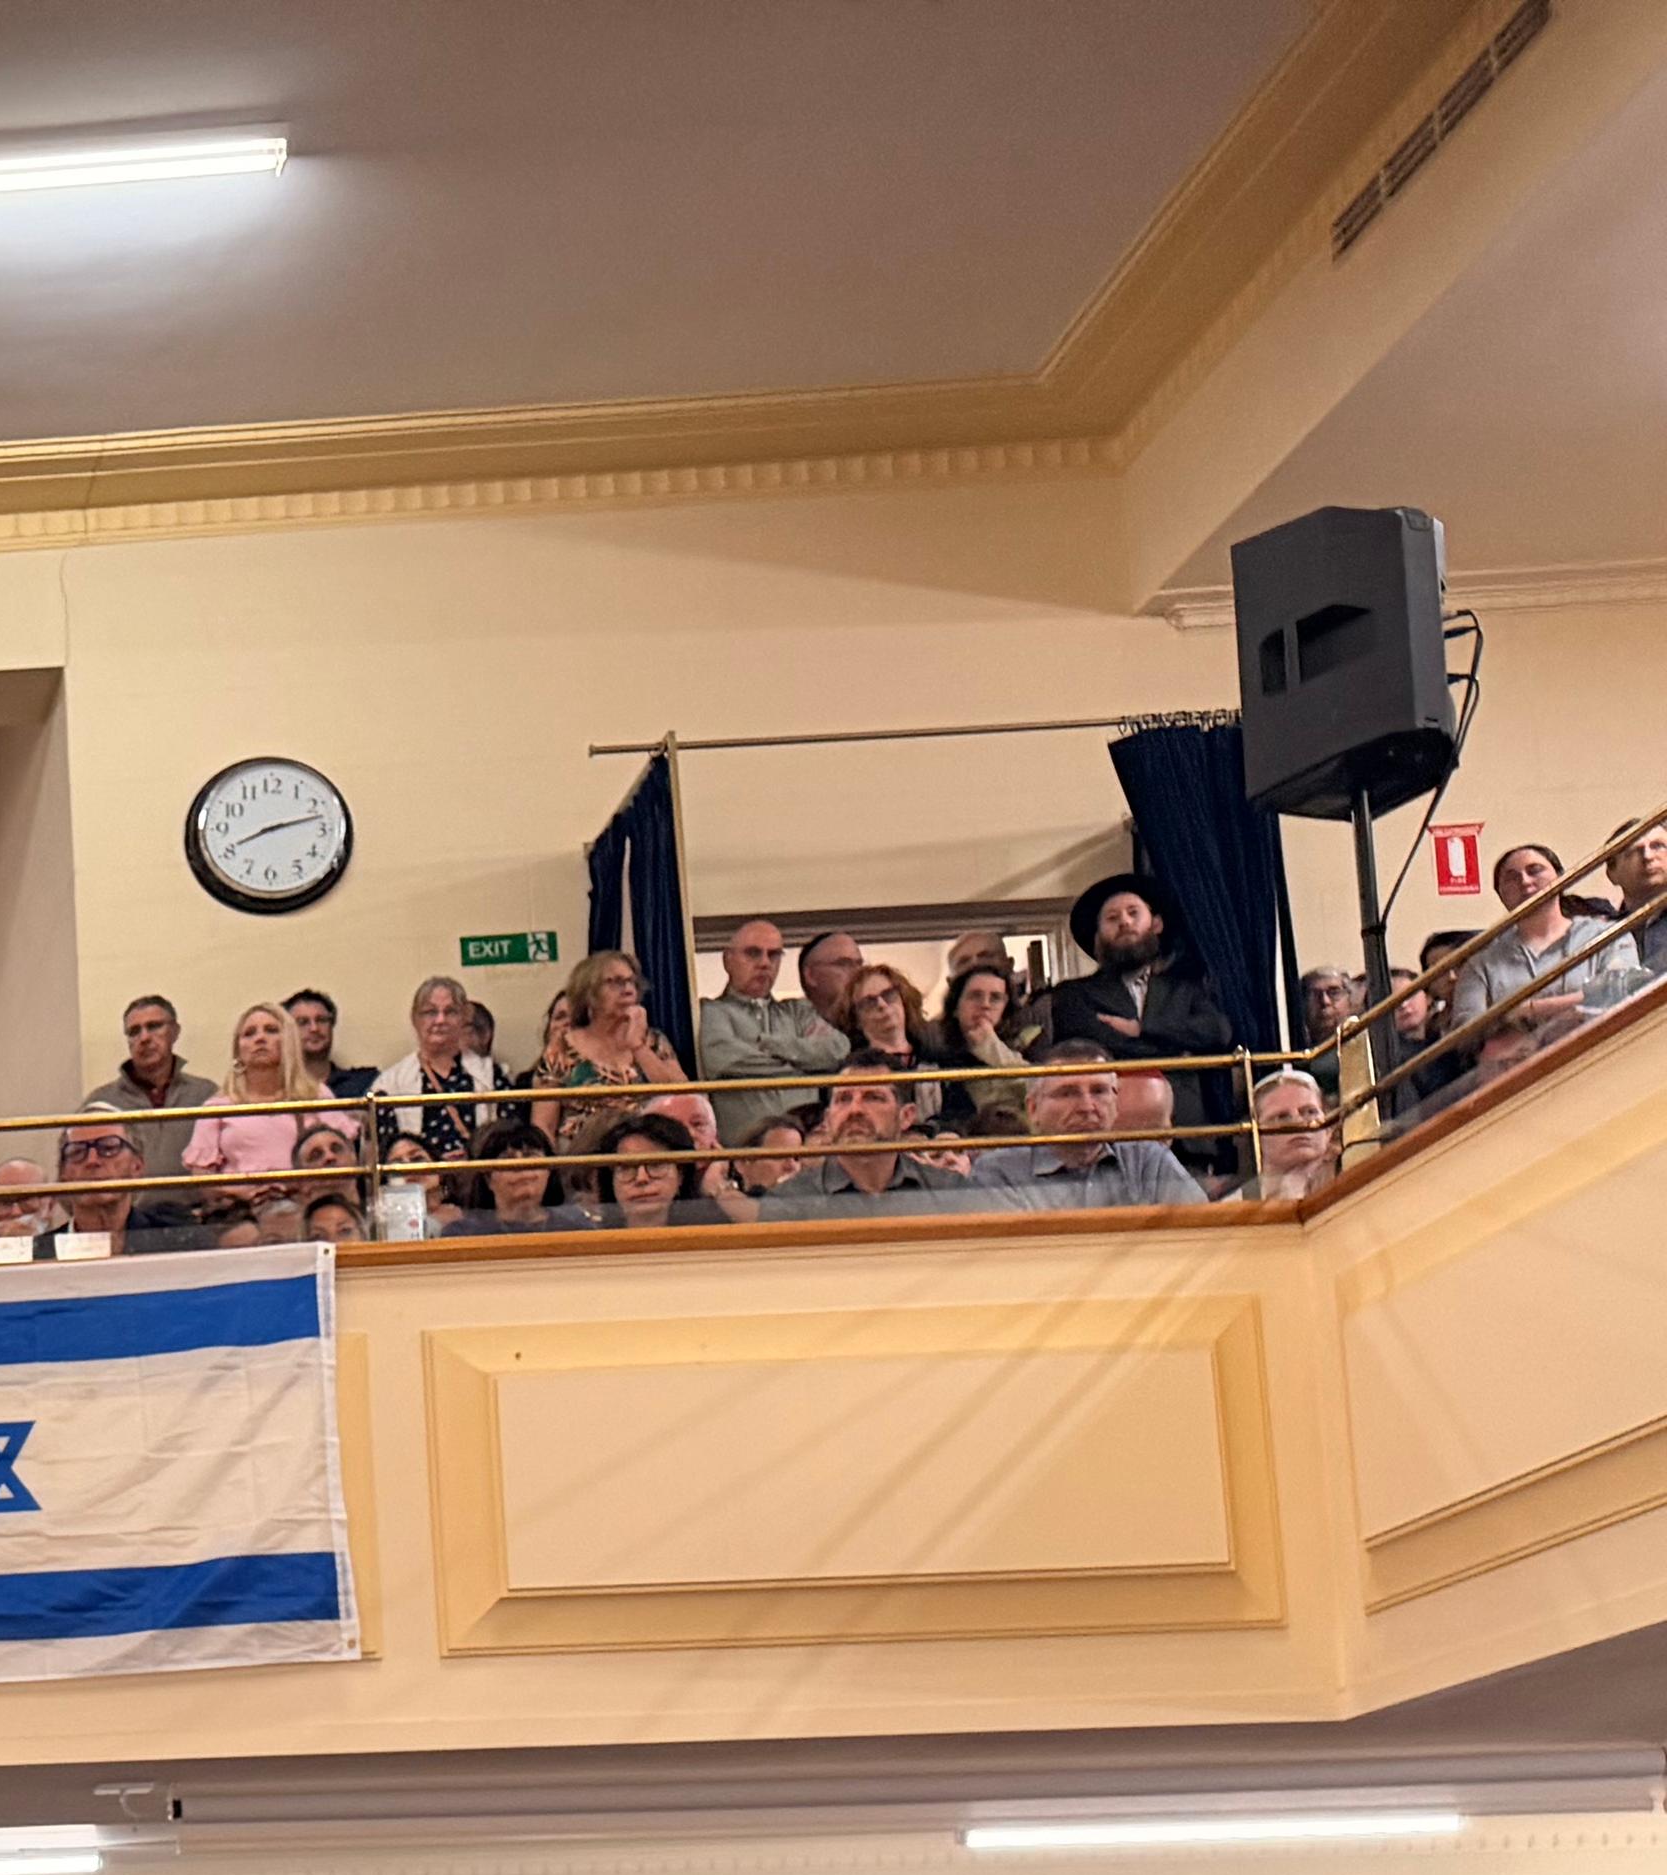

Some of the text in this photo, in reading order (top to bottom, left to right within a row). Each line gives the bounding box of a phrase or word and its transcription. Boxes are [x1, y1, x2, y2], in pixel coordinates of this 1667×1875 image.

[241, 784, 257, 800] 11
[263, 777, 283, 794] 12
[293, 784, 300, 800] 1
[225, 802, 244, 818] 10
[307, 799, 318, 813] 2
[216, 822, 229, 836] 9
[318, 823, 327, 838] 3
[223, 844, 237, 860] 8
[306, 843, 317, 858] 4
[244, 858, 255, 875] 7
[264, 865, 278, 880] 6
[292, 859, 303, 877] 5
[468, 940, 512, 958] EXIT
